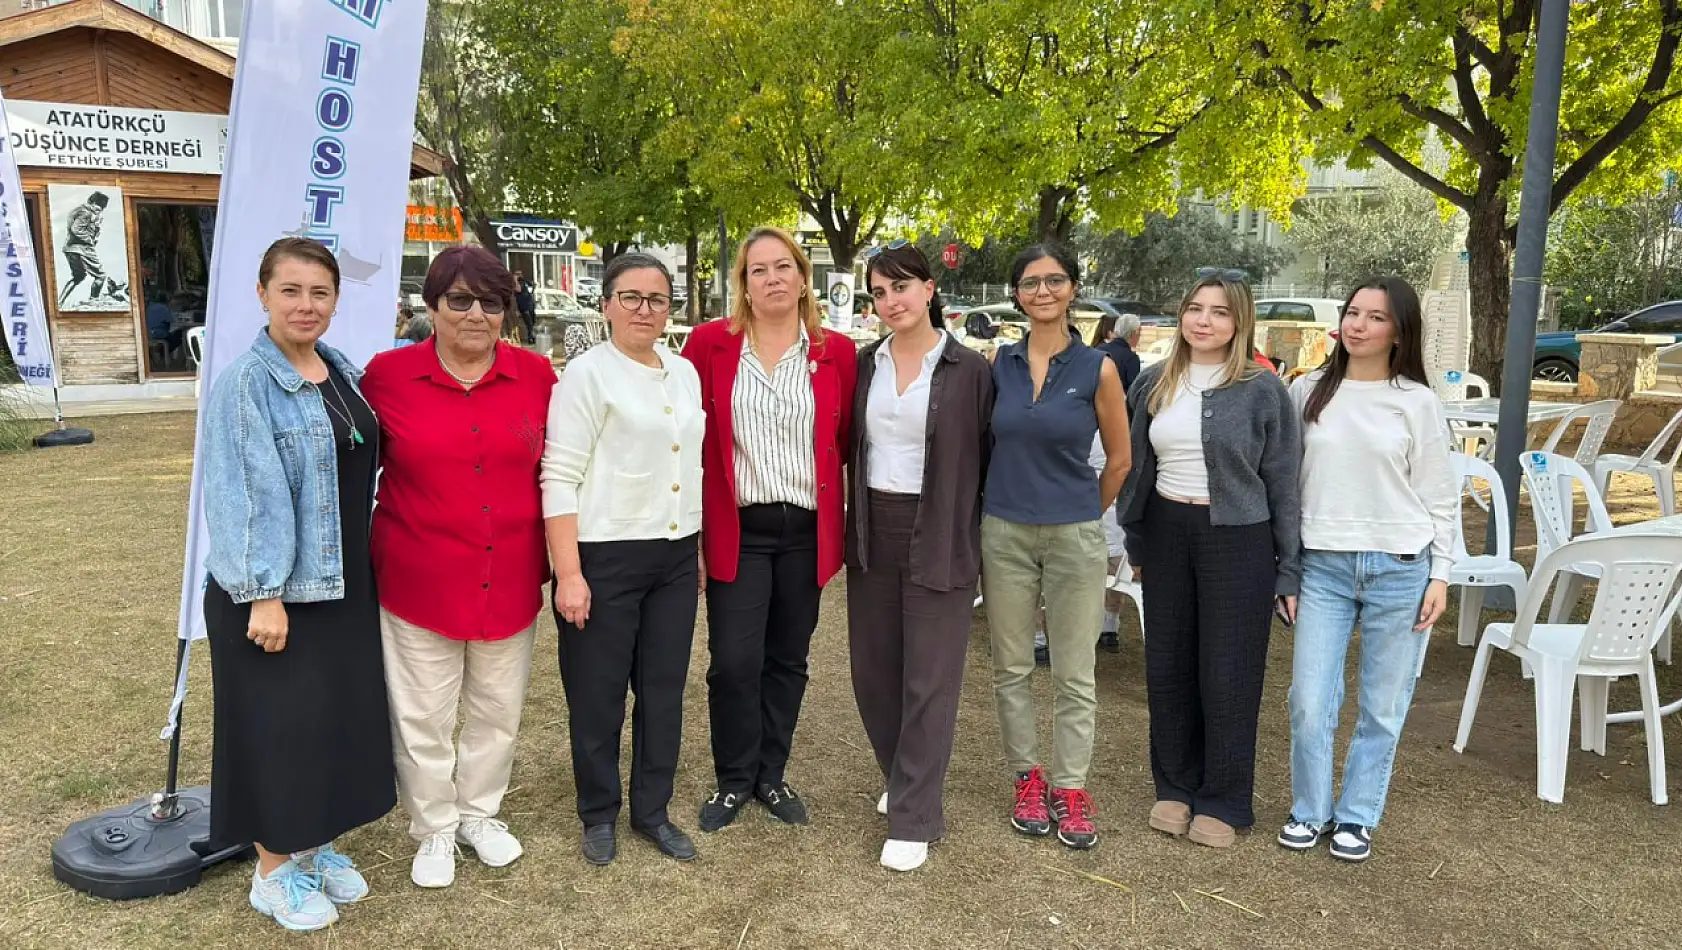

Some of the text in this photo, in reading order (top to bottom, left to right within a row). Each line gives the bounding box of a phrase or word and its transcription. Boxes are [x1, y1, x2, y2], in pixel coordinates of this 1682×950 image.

[46, 109, 166, 136] ATATÜRKÇÜ
[115, 138, 202, 158] DERNEĞİ
[48, 153, 169, 169] FETHİYE ŞUBESİ
